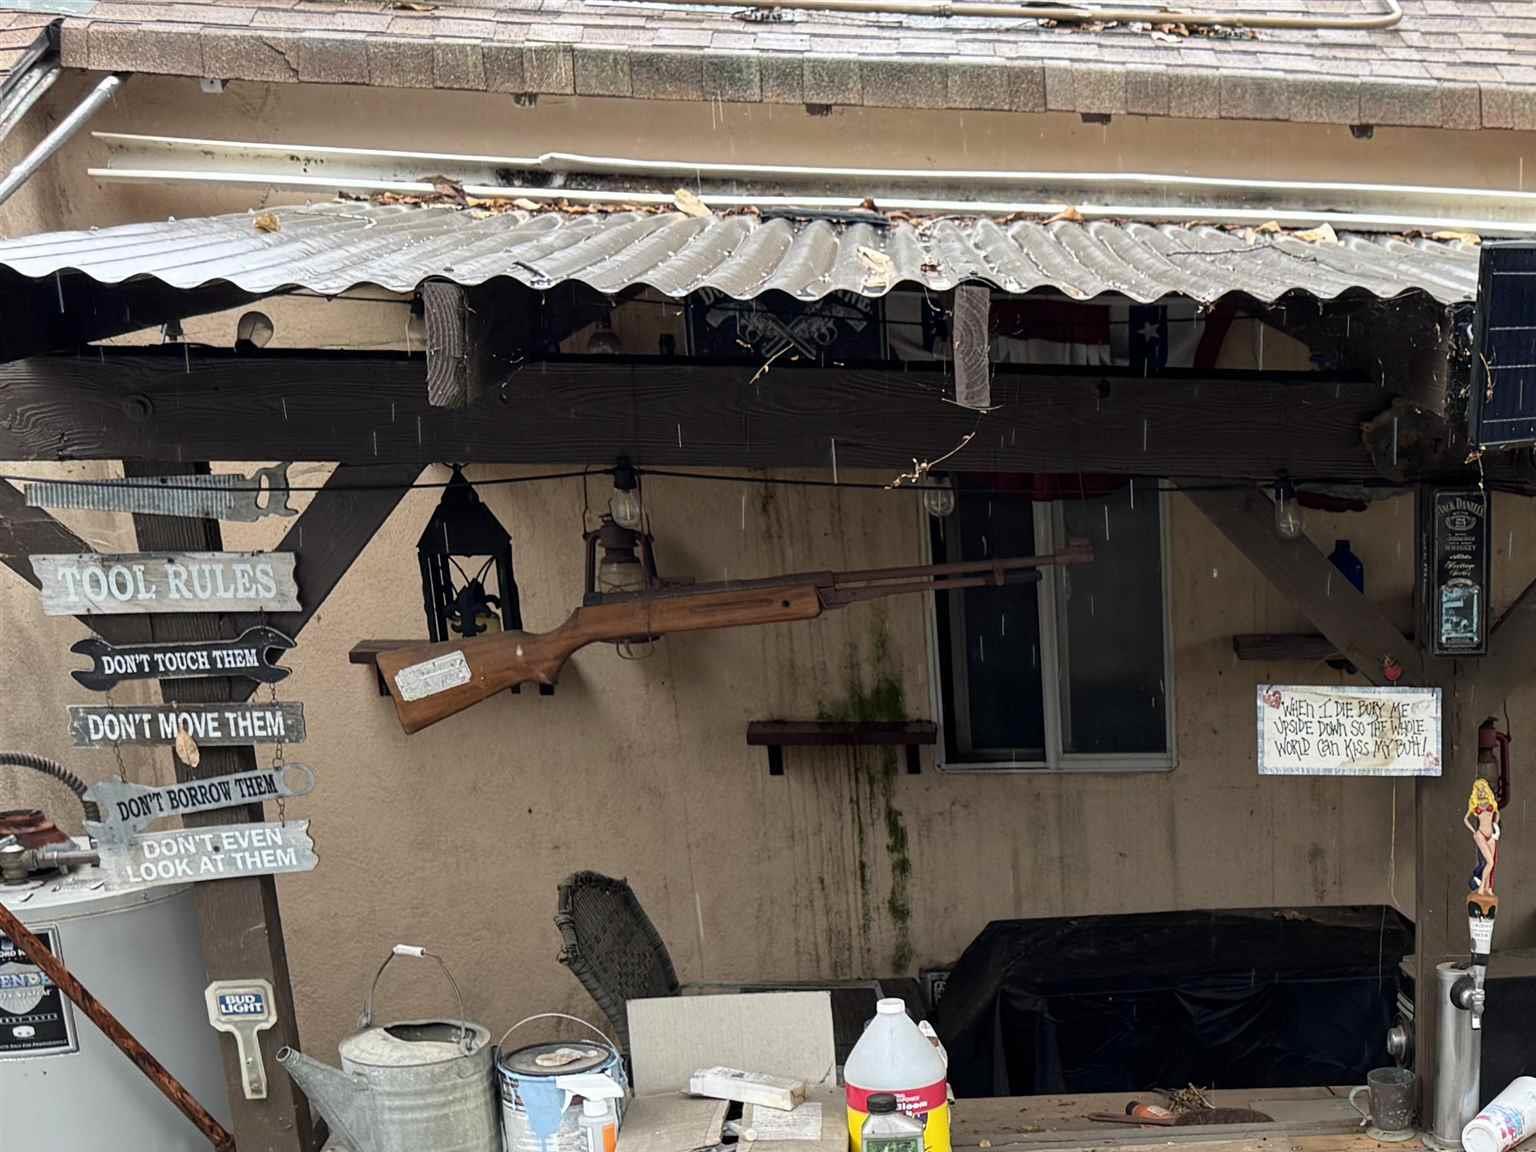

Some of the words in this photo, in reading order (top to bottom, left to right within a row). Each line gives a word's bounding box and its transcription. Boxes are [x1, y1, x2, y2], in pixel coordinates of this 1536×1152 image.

[57, 565, 157, 601] TOOL
[165, 561, 278, 598] RULES
[101, 653, 151, 675] DON'T
[154, 650, 210, 673] TOUCH
[212, 648, 260, 669] THEM
[1318, 697, 1333, 719] I
[1334, 700, 1354, 719] DIE
[1390, 702, 1410, 719] ME
[87, 713, 152, 742] DON'T
[159, 712, 222, 738] MOVE
[228, 710, 285, 736] THEM
[1350, 720, 1366, 737] SO
[1367, 719, 1388, 738] THE
[1373, 738, 1394, 759] MY
[116, 793, 166, 822] DON'T
[168, 782, 232, 811] BORROW
[234, 773, 280, 798] THEM
[143, 833, 215, 860] DON'T
[223, 827, 284, 849] EVEN
[125, 860, 194, 884] LOOK
[199, 853, 229, 876] AT
[231, 846, 298, 870] THEM
[220, 1003, 263, 1013] LIGHT
[225, 994, 256, 1004] BUD
